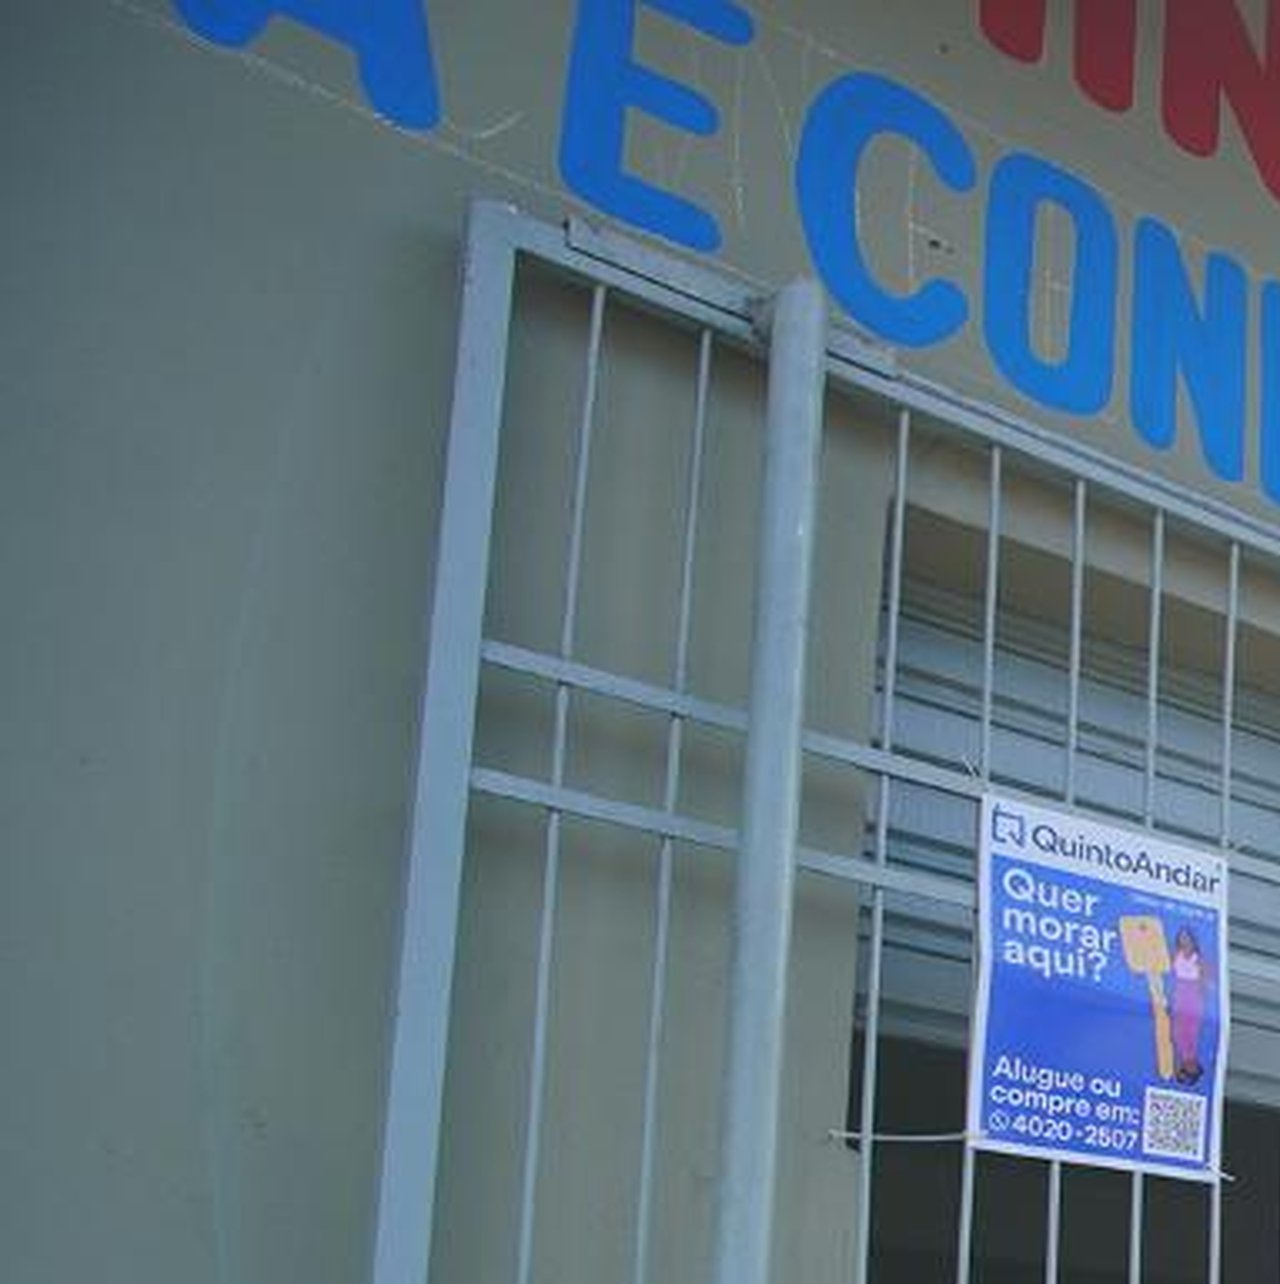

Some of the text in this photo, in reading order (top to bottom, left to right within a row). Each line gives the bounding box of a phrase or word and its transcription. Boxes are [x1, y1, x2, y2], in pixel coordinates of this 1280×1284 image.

[1032, 823, 1221, 894] QuintoAndar
[1003, 868, 1099, 916] Quer
[1003, 907, 1118, 952] morar
[1003, 939, 1108, 982] aqui?
[992, 1055, 1121, 1099] Alugue ou
[990, 1085, 1091, 1118] compre
